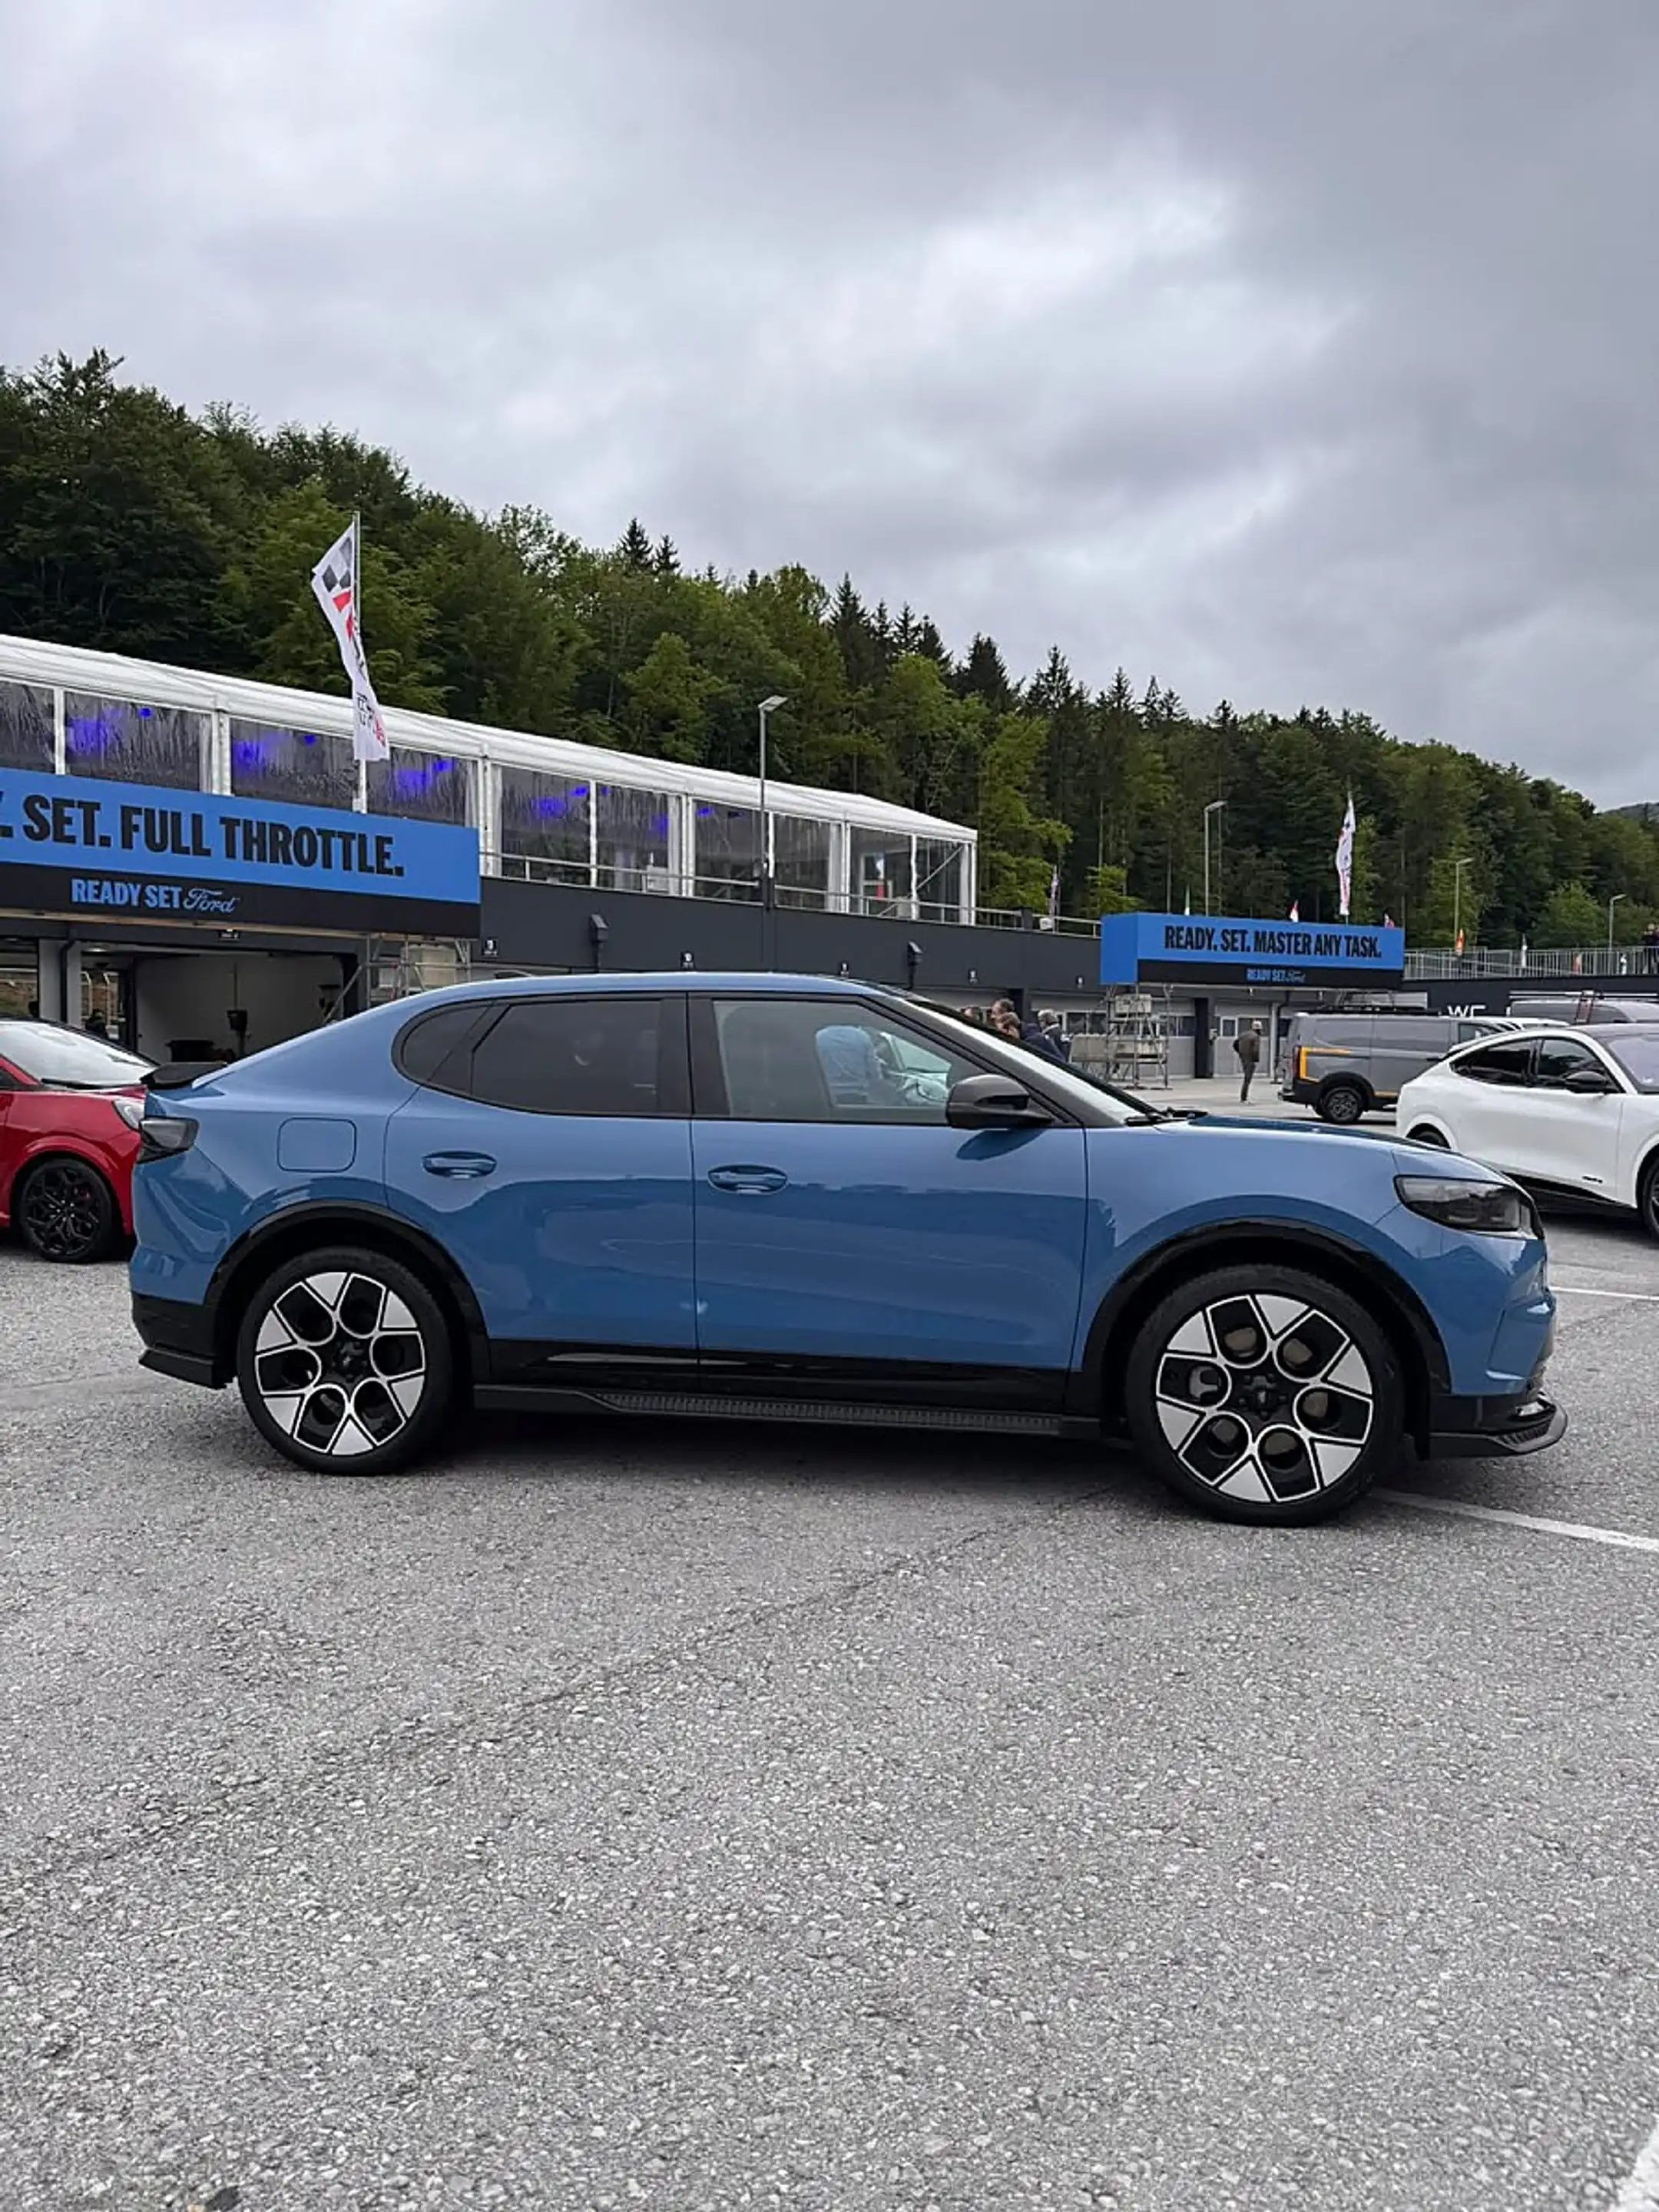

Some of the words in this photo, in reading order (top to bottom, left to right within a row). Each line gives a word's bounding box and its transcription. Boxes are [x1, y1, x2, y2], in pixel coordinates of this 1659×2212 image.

[22, 794, 111, 847] SET.
[121, 805, 211, 857] FULL
[220, 816, 405, 876] THROTTLE.
[71, 879, 141, 906] READY
[144, 884, 182, 908] SET
[183, 887, 240, 913] Ford
[1164, 926, 1218, 951] READY.
[1220, 929, 1250, 952] SET.
[1253, 930, 1312, 955] MASTER
[1314, 933, 1342, 956] ANY
[1344, 935, 1382, 958] TASK.
